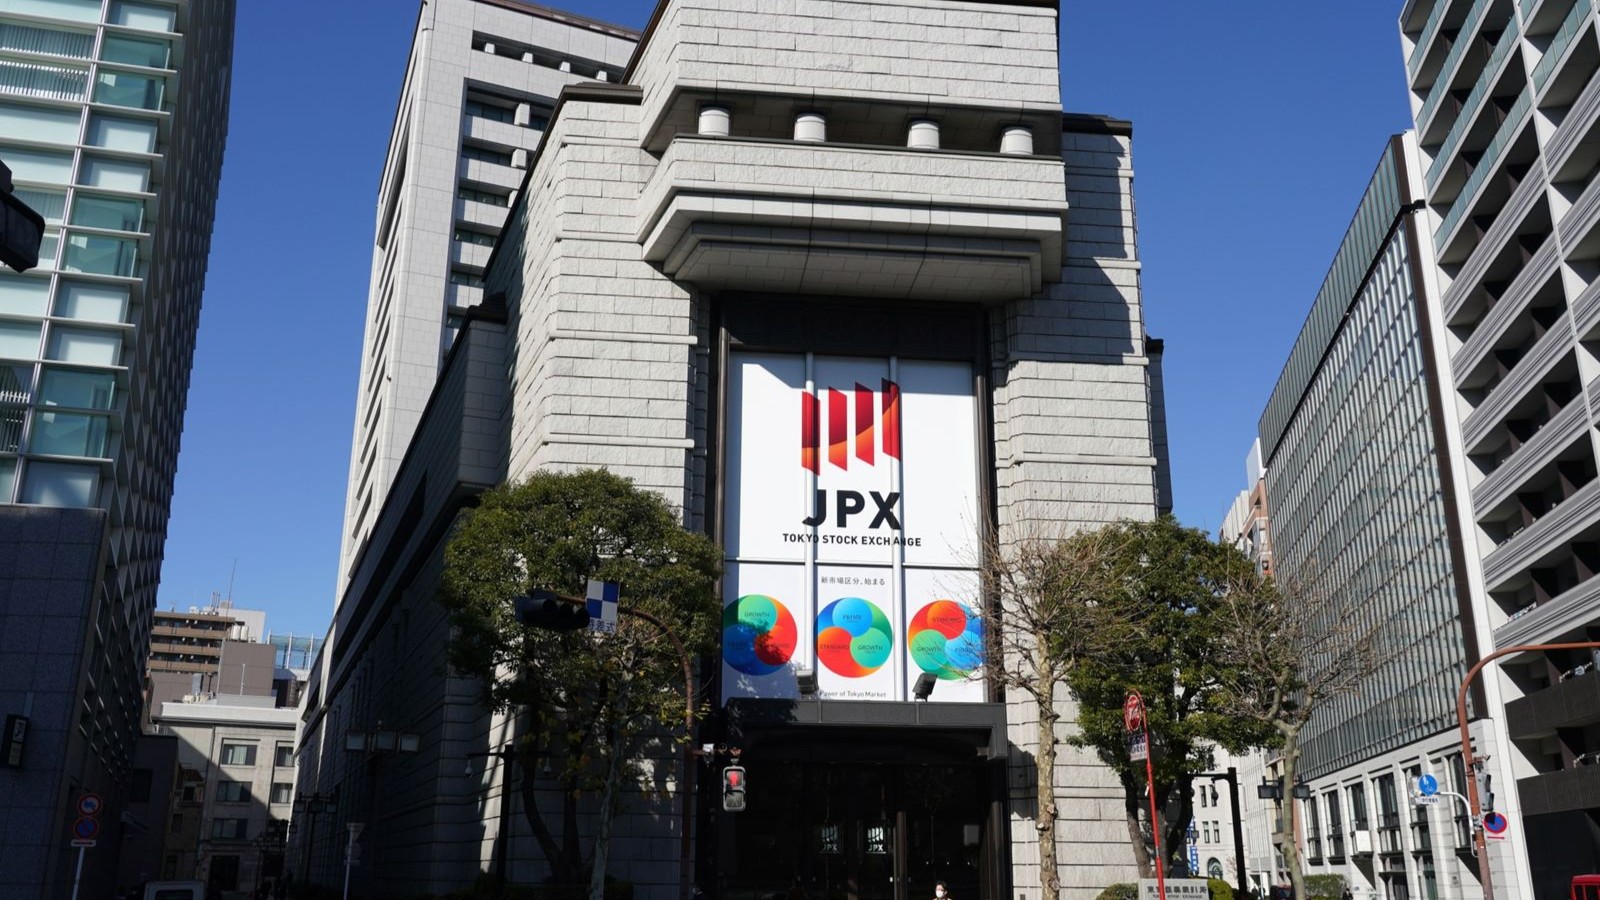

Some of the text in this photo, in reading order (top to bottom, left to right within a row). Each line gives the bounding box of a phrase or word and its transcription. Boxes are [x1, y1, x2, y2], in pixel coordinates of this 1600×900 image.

[802, 489, 901, 530] JPX
[782, 533, 922, 547] TOKYO STOCK EXCHANGE
[847, 690, 865, 698] Tokyo
[823, 843, 837, 851] JPX
[868, 843, 883, 851] JPX
